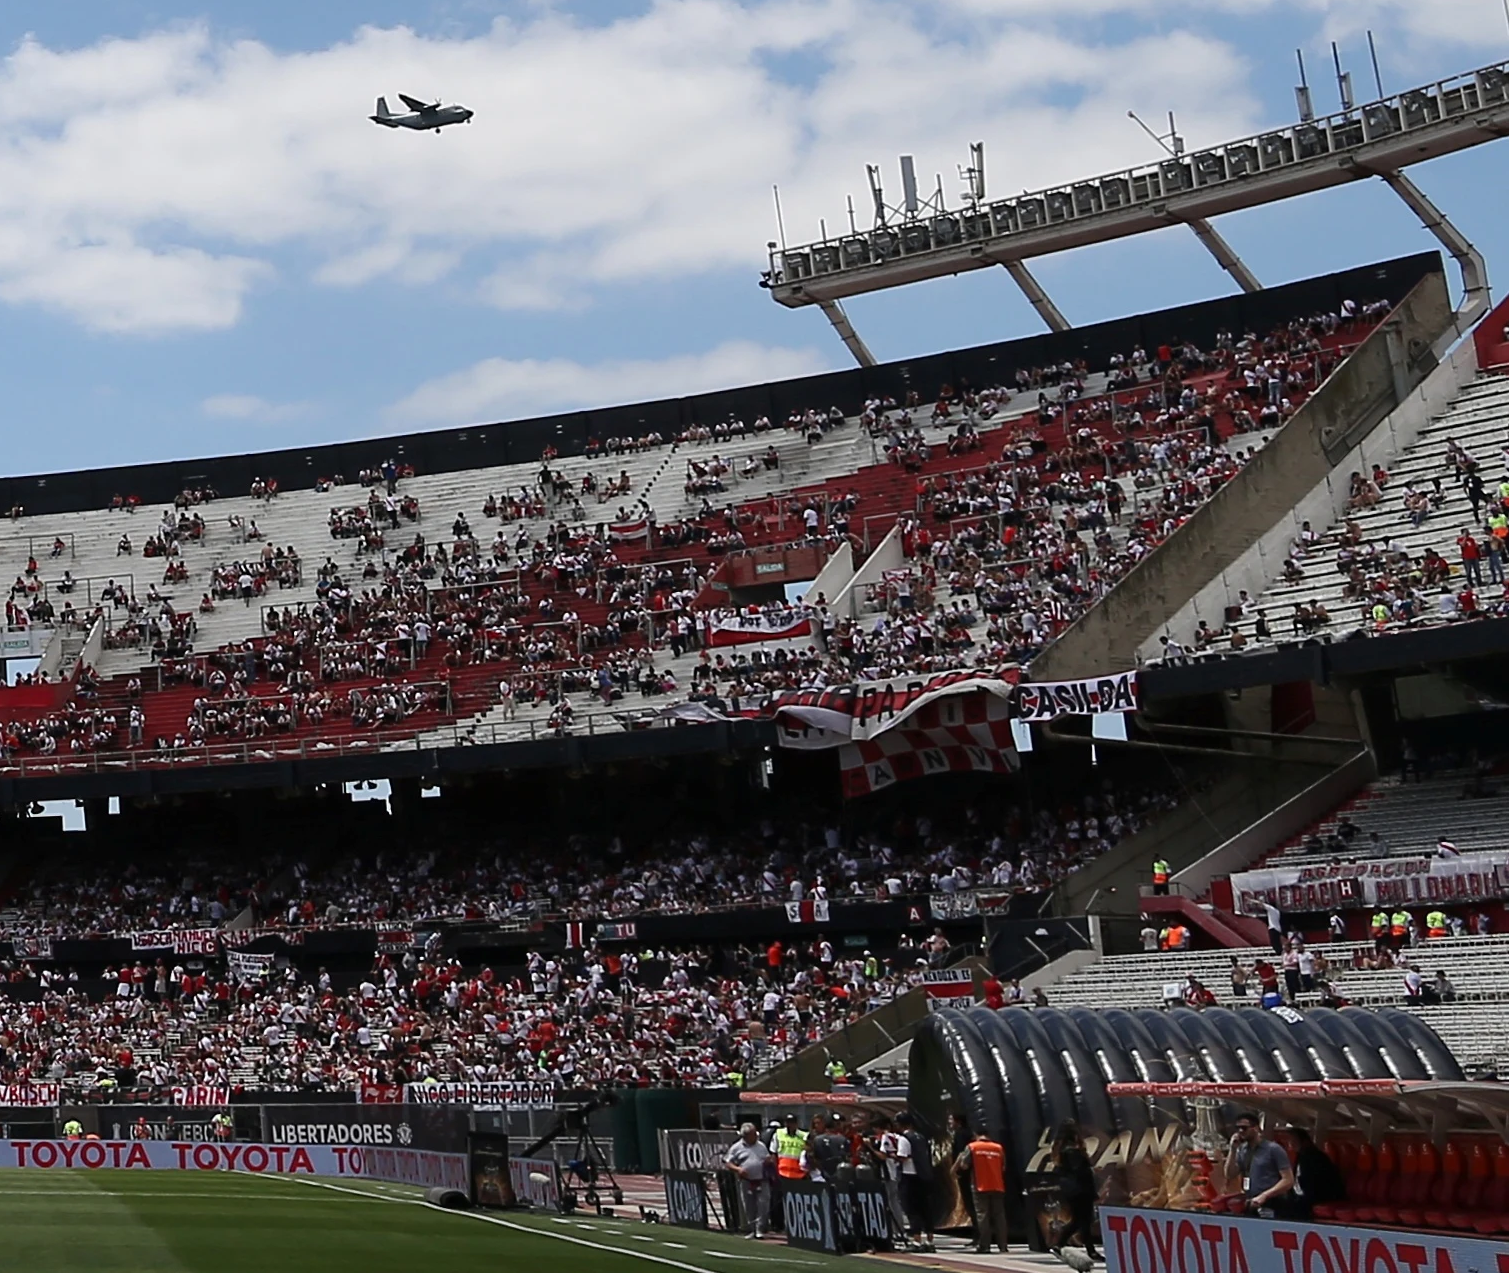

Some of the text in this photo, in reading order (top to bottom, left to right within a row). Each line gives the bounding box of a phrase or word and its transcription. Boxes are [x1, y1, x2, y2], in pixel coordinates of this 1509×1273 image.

[1016, 674, 1134, 719] CASILDA
[1340, 880, 1352, 896] H
[909, 907, 920, 921] A
[616, 924, 635, 937] TU
[205, 941, 215, 952] C
[454, 1082, 552, 1104] LIBERTADOR
[271, 1123, 393, 1145] LIBERTADORES
[11, 1142, 151, 1168] TOYOTA
[172, 1143, 315, 1173] TOYOTA
[1107, 1215, 1250, 1273] TOYOTA
[1273, 1229, 1458, 1273] TOYOTA
